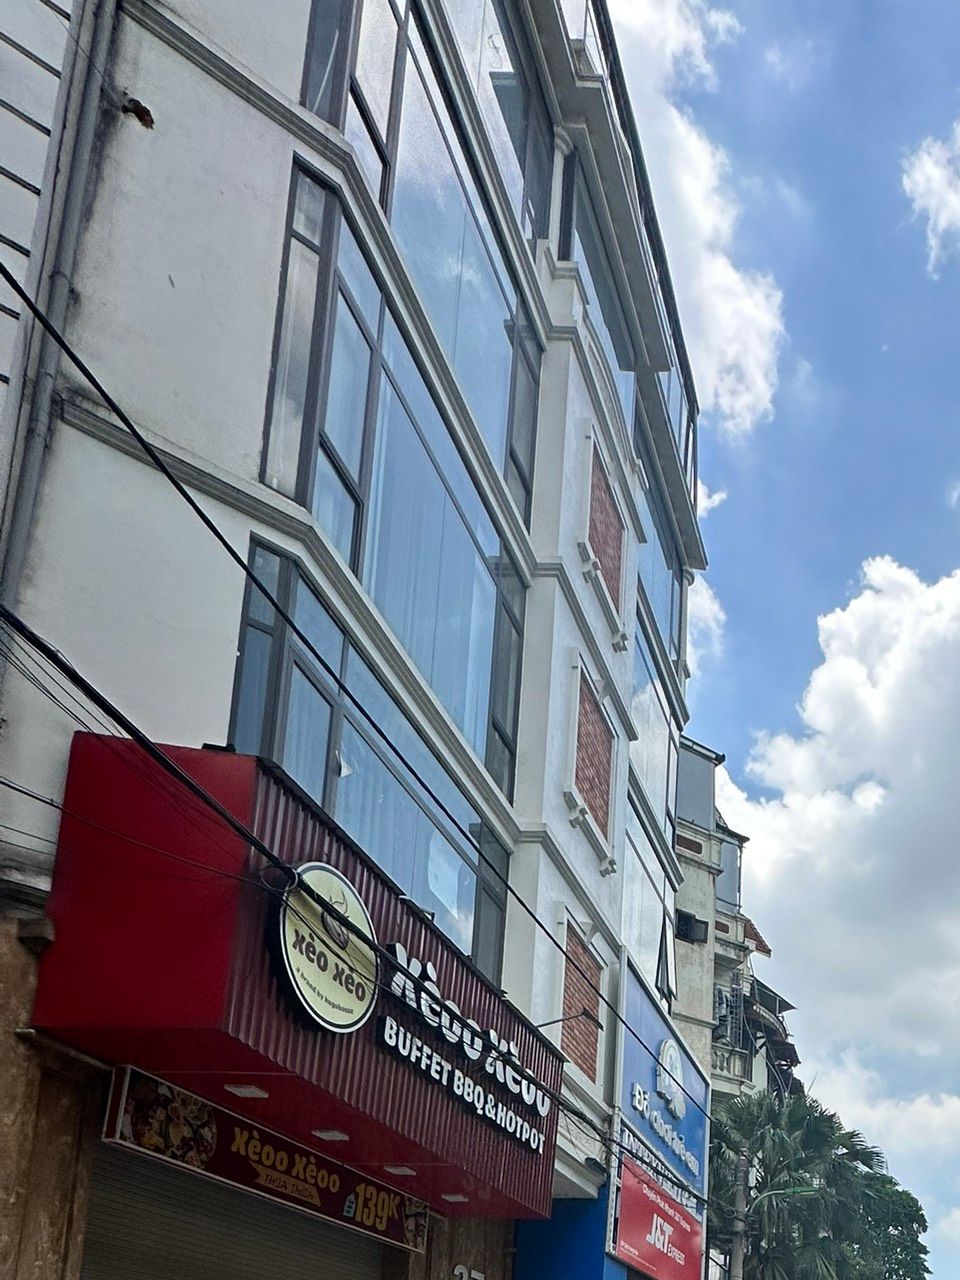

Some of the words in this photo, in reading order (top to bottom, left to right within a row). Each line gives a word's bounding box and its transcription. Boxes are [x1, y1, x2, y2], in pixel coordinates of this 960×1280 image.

[292, 928, 329, 972] xèo
[383, 1015, 452, 1086] BUFFET
[231, 1126, 288, 1172] Xèoo
[291, 1153, 340, 1193] Xèoo
[355, 1182, 400, 1231] 139K
[645, 1213, 674, 1255] J&T
